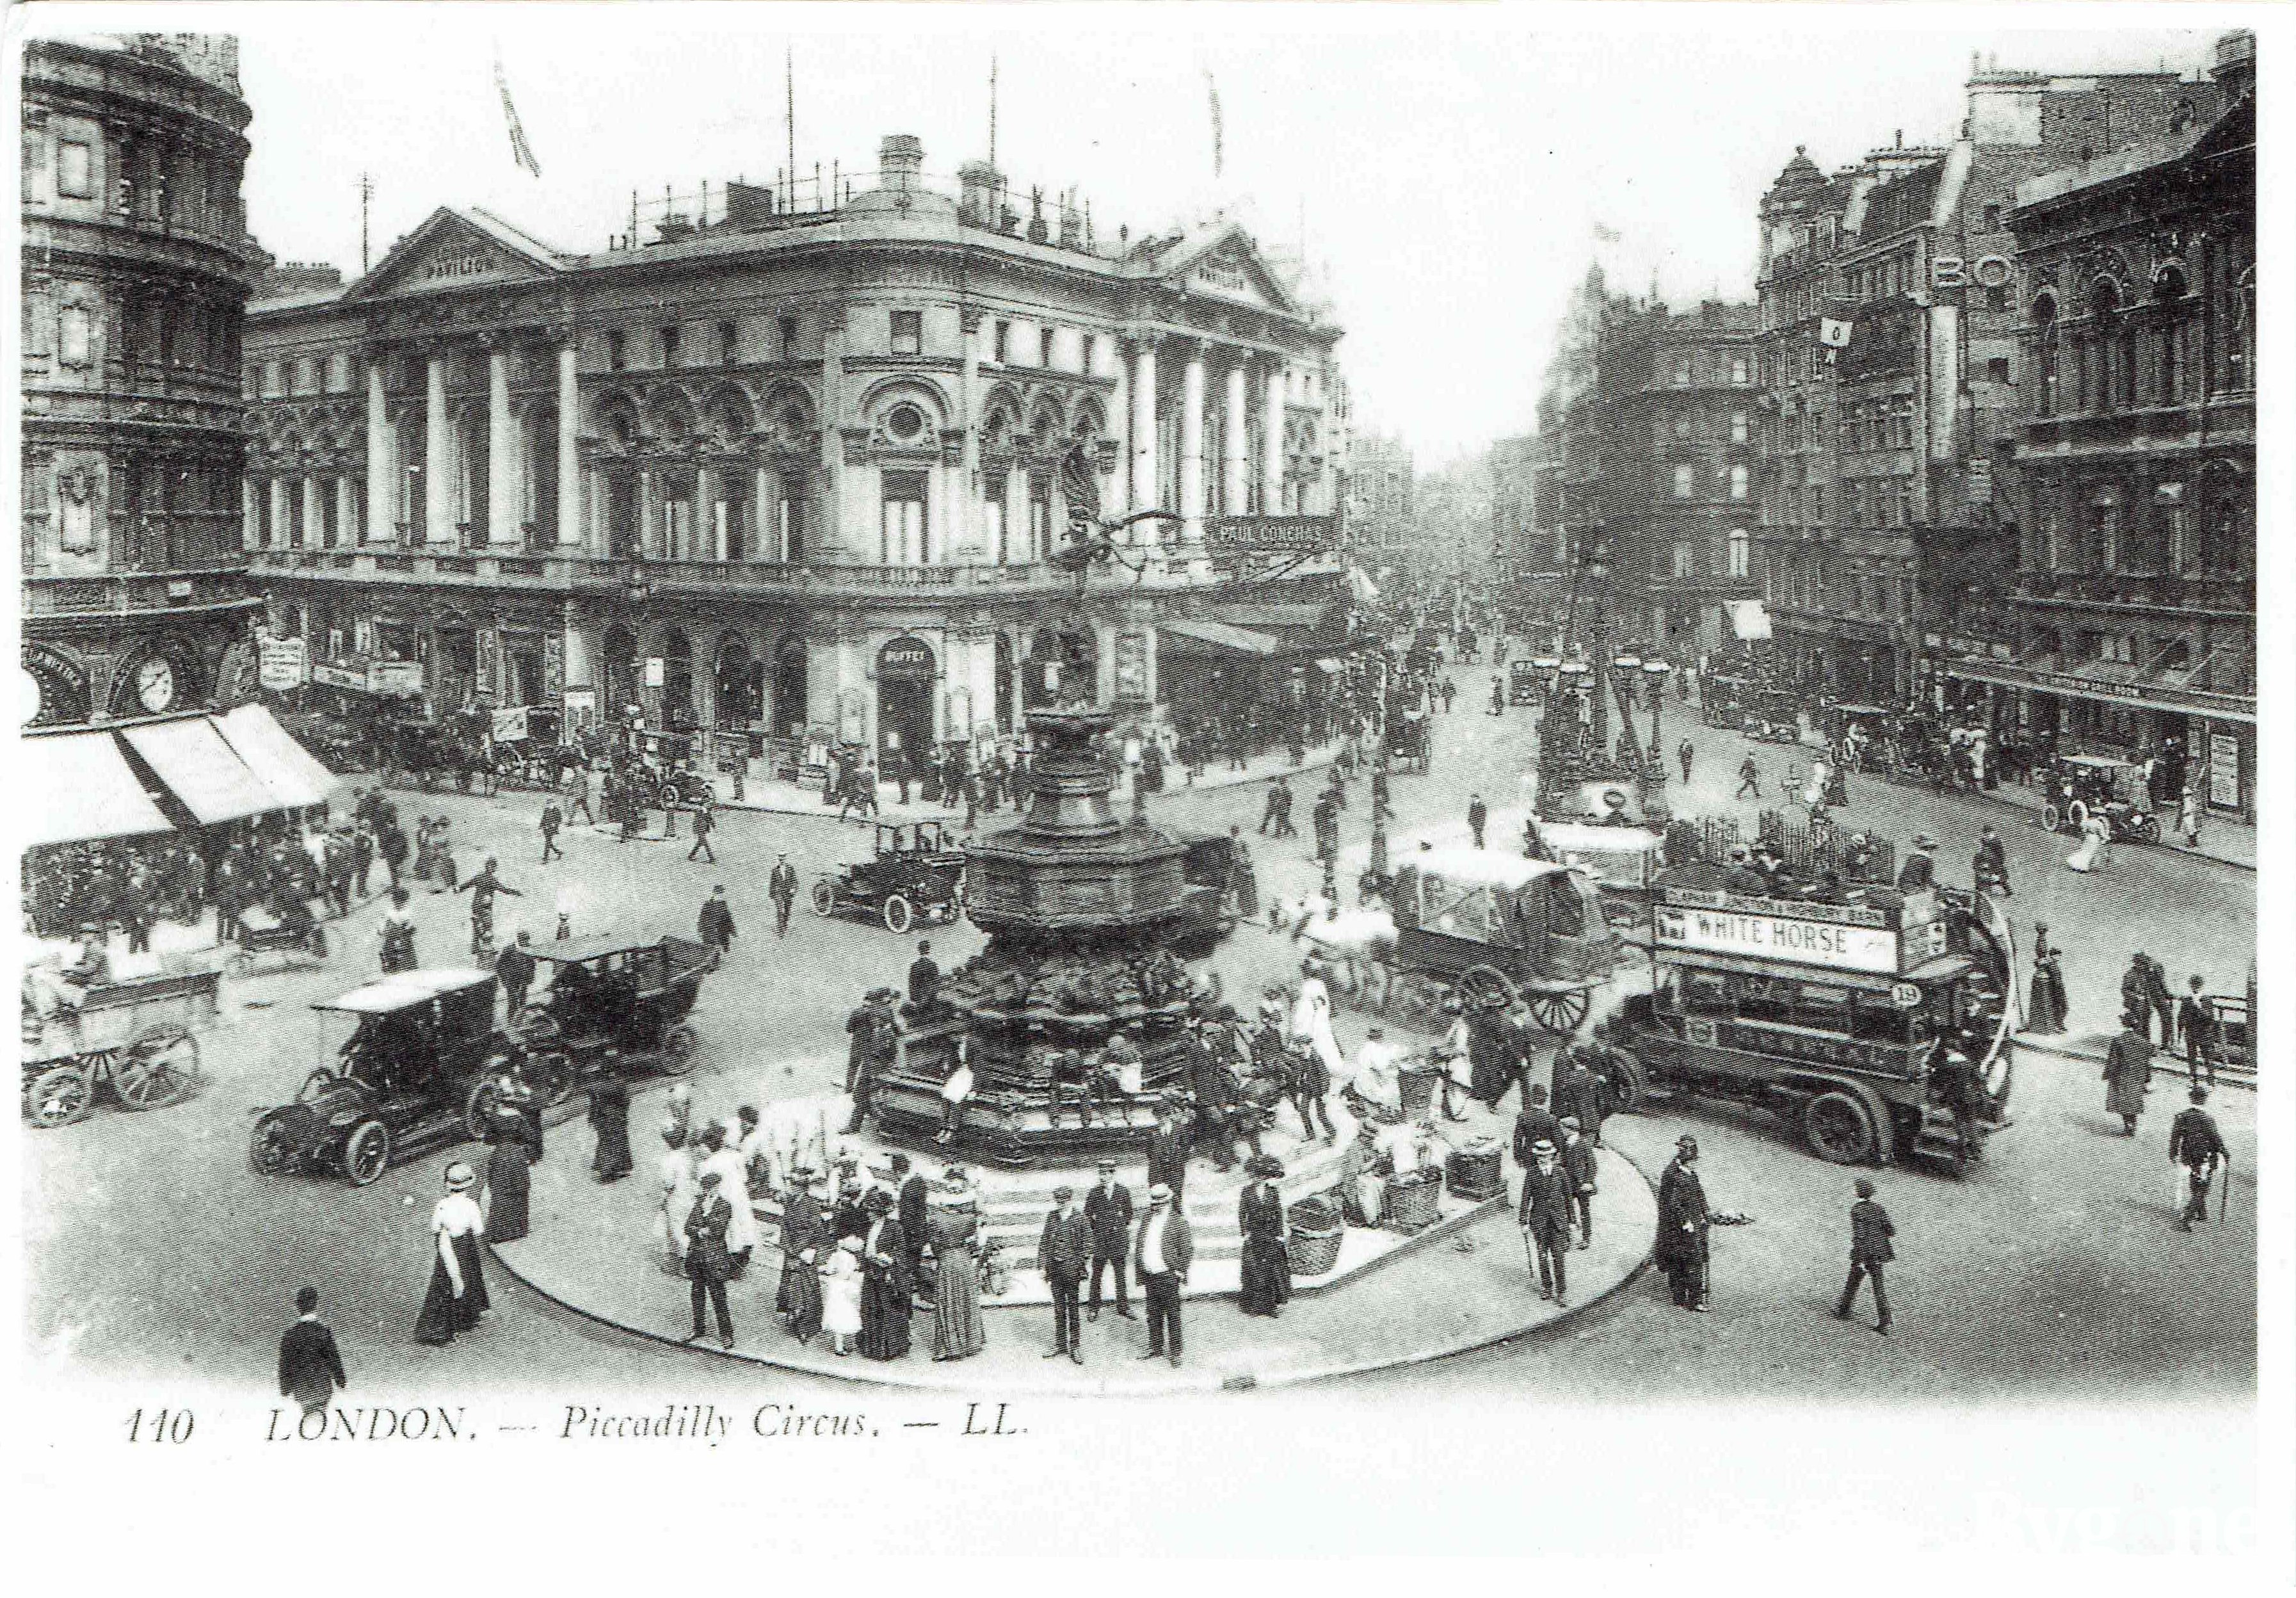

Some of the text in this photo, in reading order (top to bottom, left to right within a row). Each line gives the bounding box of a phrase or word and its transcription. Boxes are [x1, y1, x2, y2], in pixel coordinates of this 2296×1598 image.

[1219, 525, 1256, 542] PAUL
[1696, 913, 1763, 945] WHITE
[1772, 921, 1848, 955] HORSE
[1897, 987, 1918, 1001] 19
